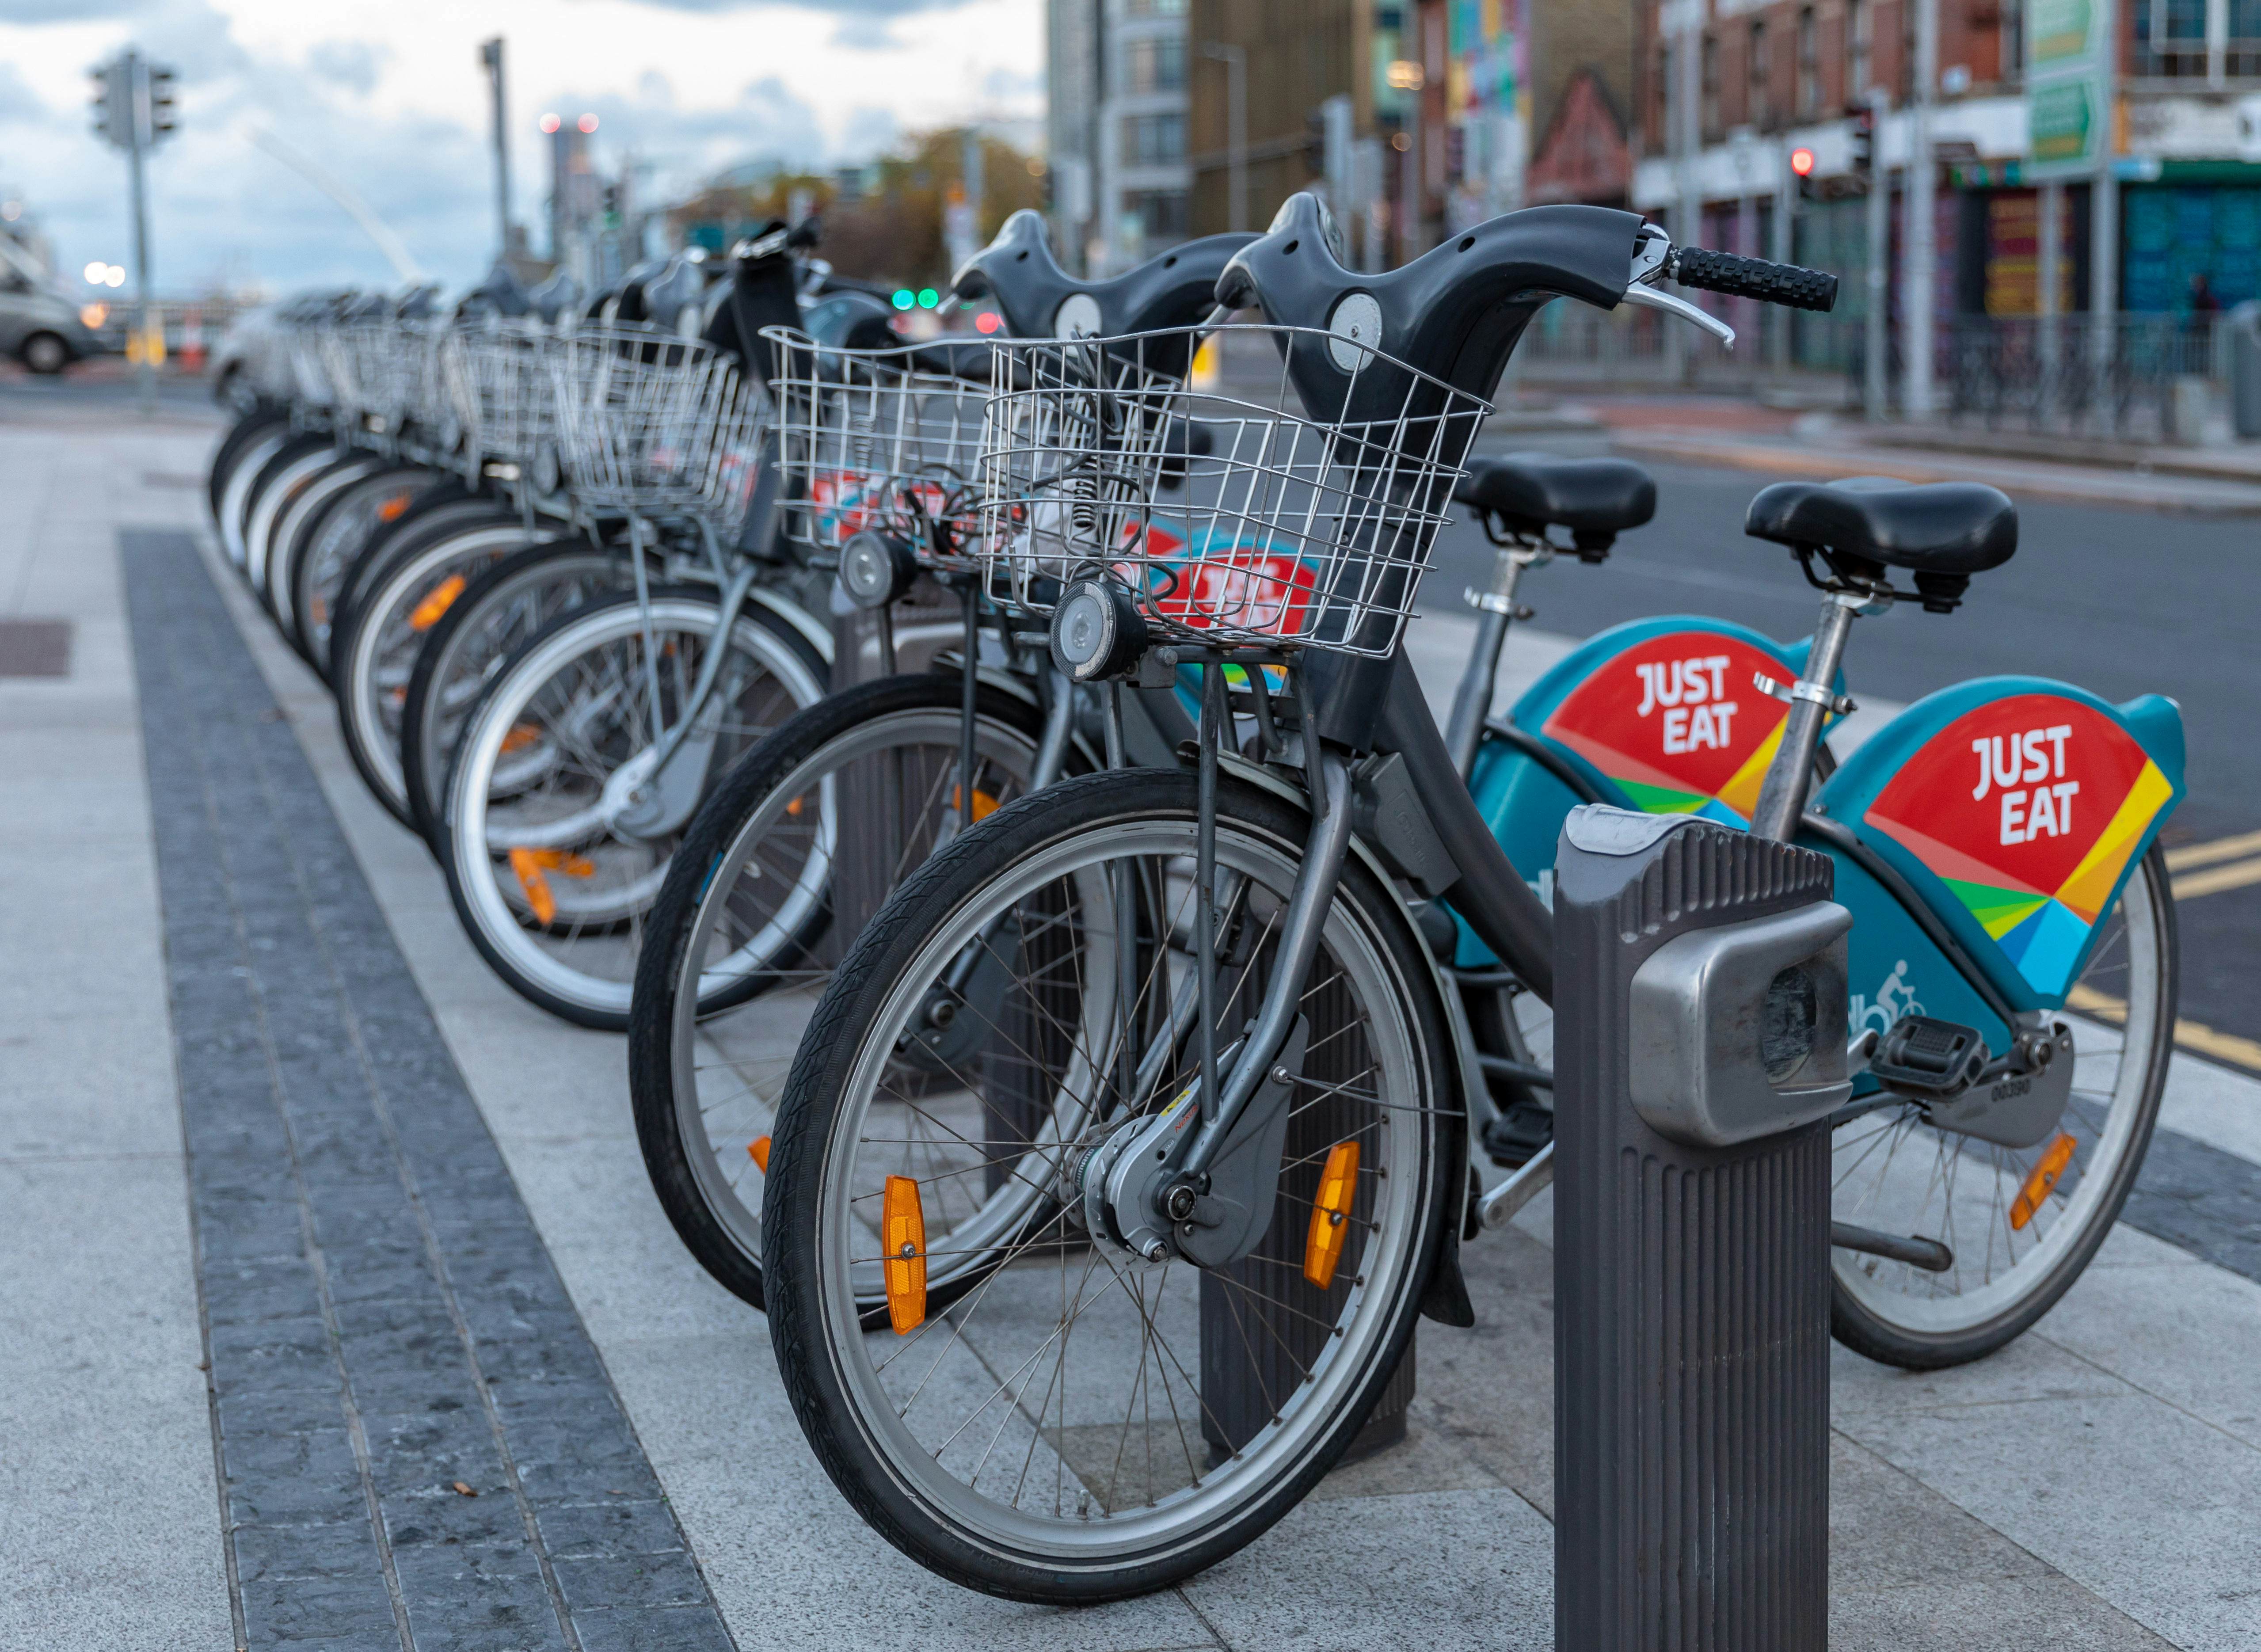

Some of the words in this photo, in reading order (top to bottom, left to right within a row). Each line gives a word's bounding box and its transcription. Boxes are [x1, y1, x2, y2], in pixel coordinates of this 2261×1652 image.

[1637, 656, 1730, 717] JUST
[1663, 702, 1738, 754] EAT
[1972, 725, 2072, 801] JUST
[2000, 781, 2079, 846] EAT
[908, 889, 959, 948] SCHWALBE
